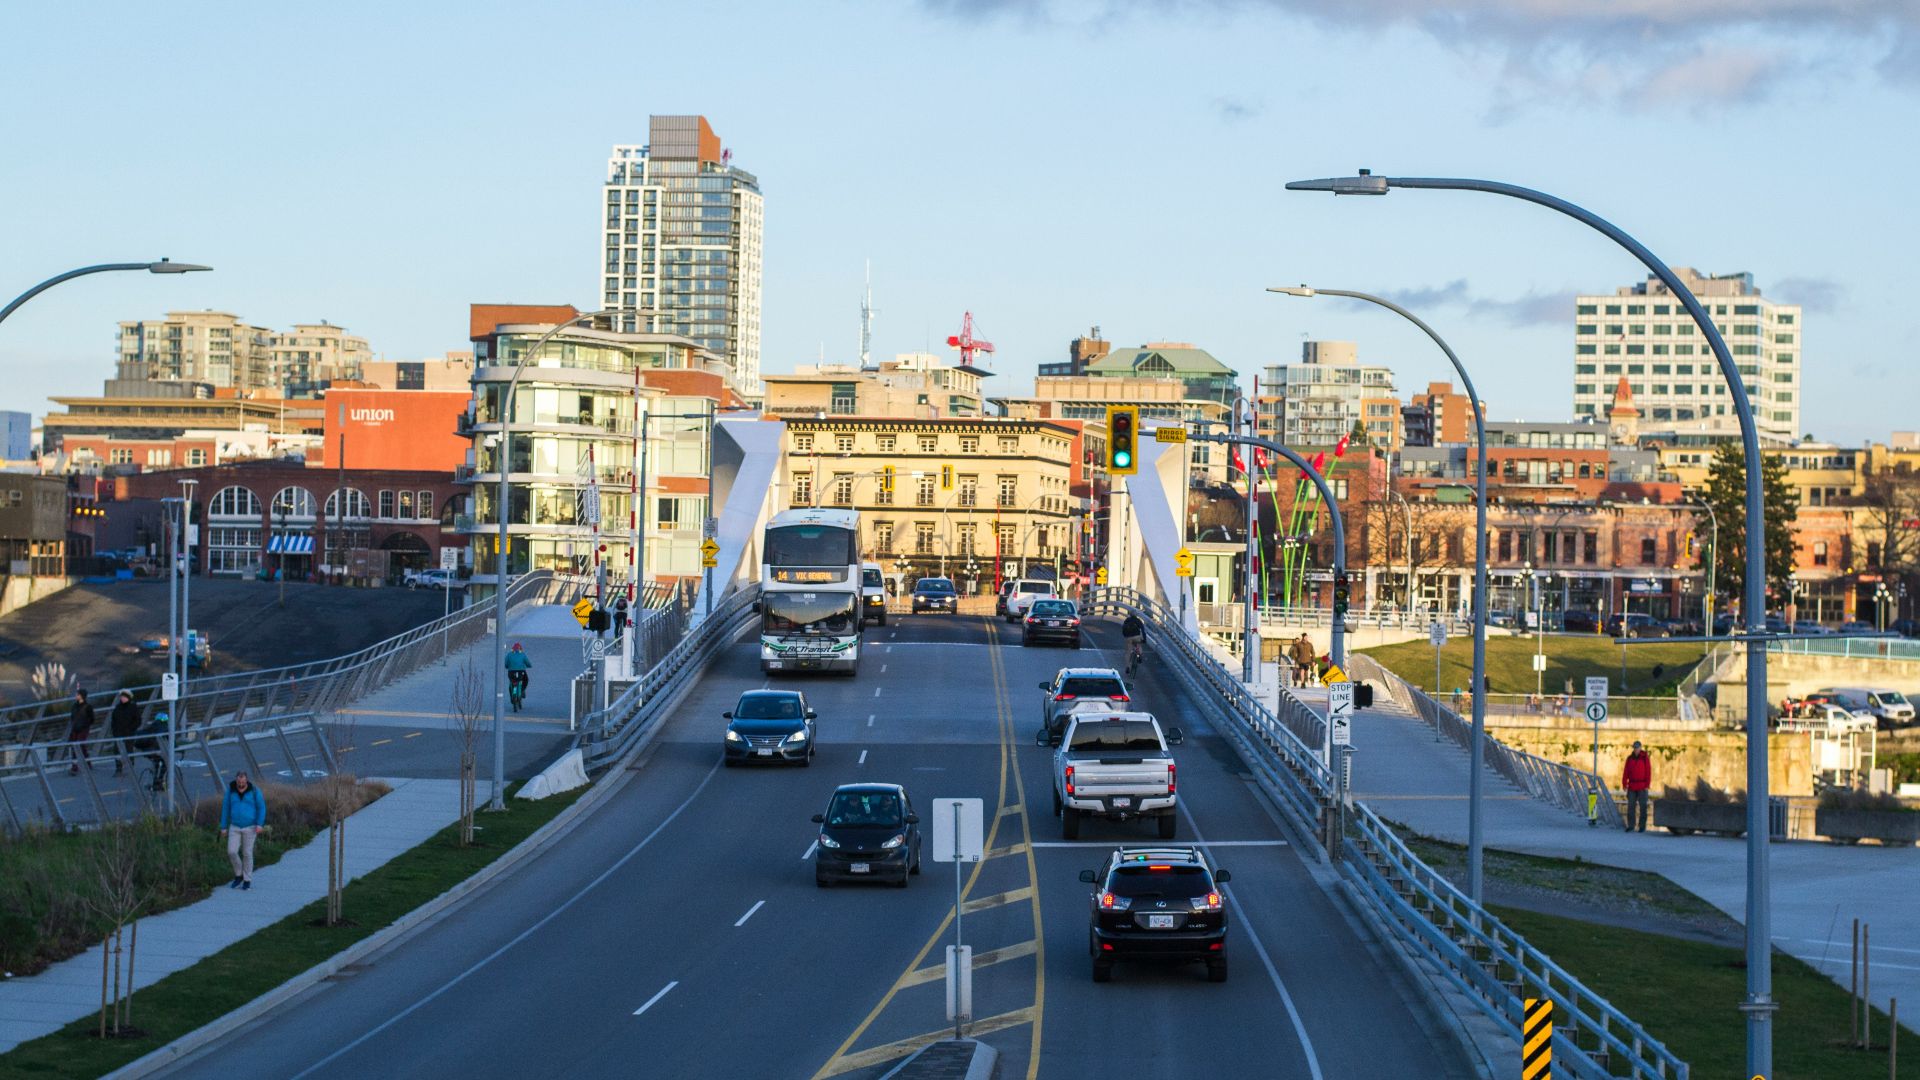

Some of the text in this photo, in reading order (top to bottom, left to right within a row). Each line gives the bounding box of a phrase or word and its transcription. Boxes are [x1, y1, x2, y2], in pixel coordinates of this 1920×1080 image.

[351, 408, 394, 421] union
[777, 571, 832, 580] 14 VIC GENERAL
